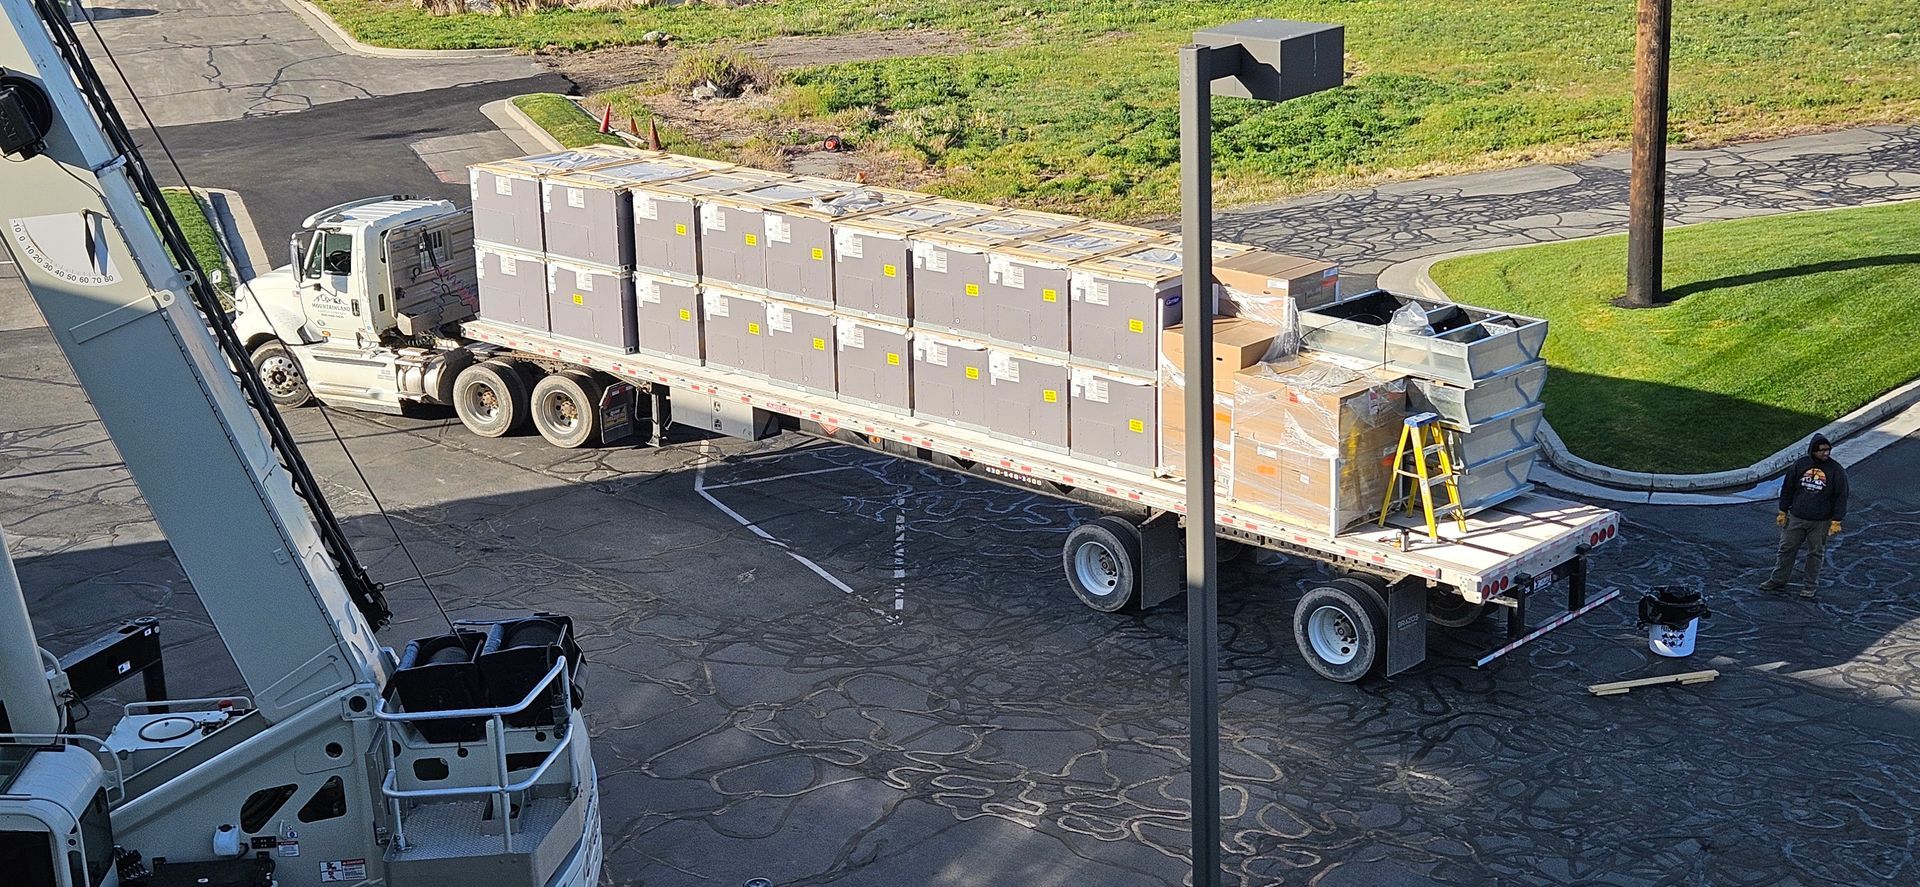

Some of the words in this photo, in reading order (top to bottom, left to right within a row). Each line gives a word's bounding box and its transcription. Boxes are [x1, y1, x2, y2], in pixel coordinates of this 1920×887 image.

[25, 245, 35, 255] 10
[33, 254, 43, 264] 20
[43, 262, 54, 272] 30
[54, 269, 65, 278] 40
[66, 273, 77, 282] 50
[79, 276, 90, 284] 60
[92, 276, 102, 284] 70
